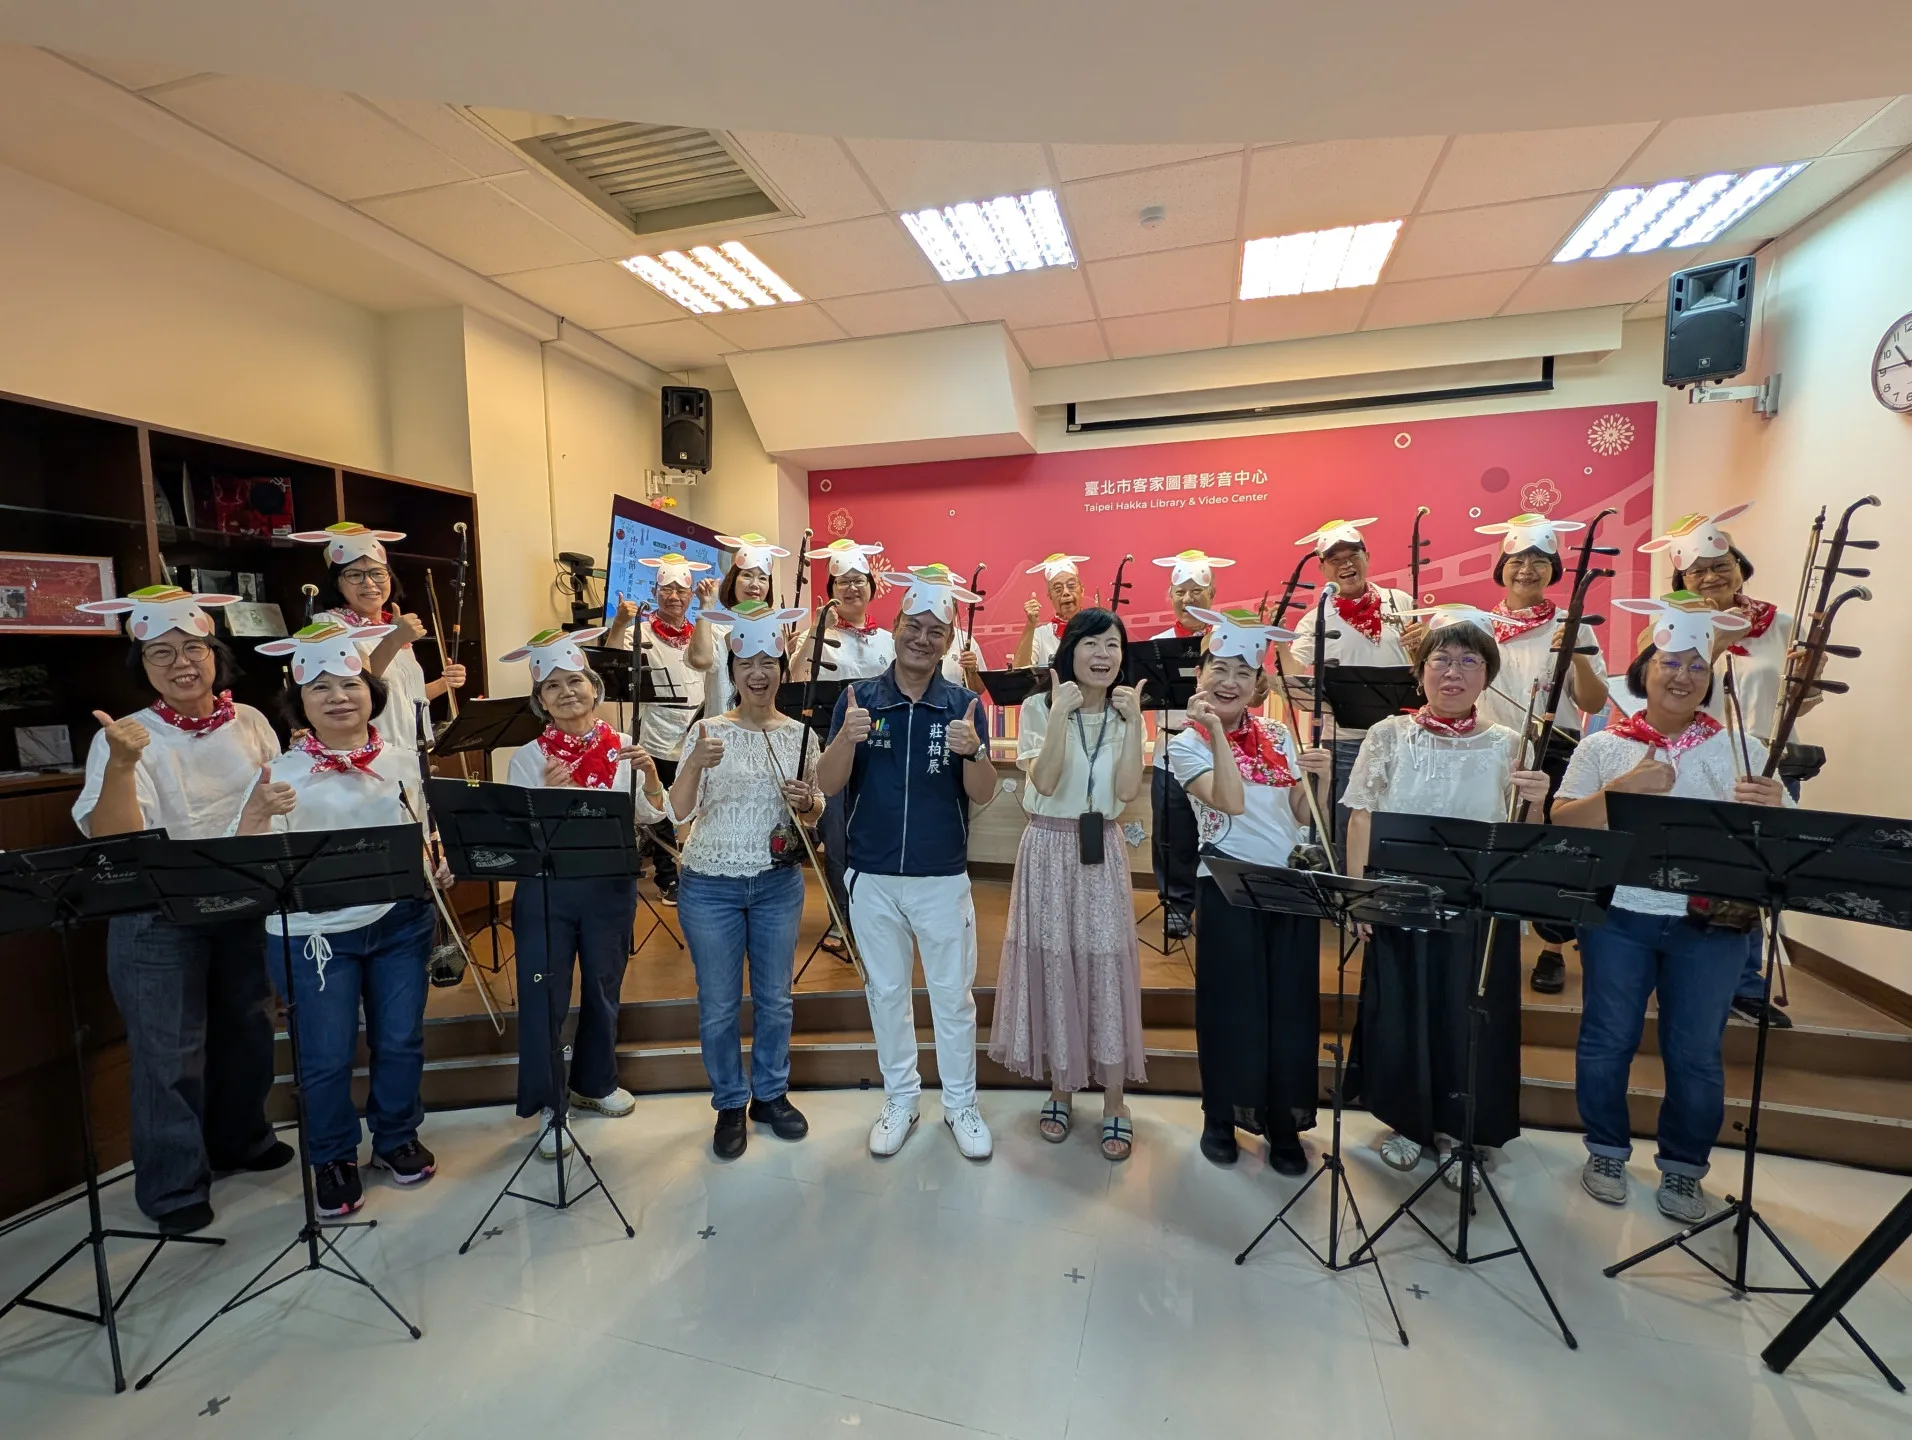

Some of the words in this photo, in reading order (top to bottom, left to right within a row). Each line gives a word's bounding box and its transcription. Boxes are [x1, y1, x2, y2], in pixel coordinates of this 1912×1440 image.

[1893, 331, 1900, 342] 11
[1883, 349, 1892, 360] 10
[1879, 367, 1887, 378] 9
[1883, 383, 1891, 393] 8
[1893, 392, 1900, 402] 7
[1084, 468, 1268, 496] 臺北市客家圖書影音中心
[1084, 502, 1113, 512] Taipei
[1116, 500, 1147, 510] Hakka
[1150, 497, 1186, 508] Library
[1188, 497, 1196, 506] &
[1198, 495, 1229, 505] Video
[1231, 493, 1268, 503] Center
[867, 738, 892, 749] 中正區
[926, 722, 944, 775] 莊柏辰
